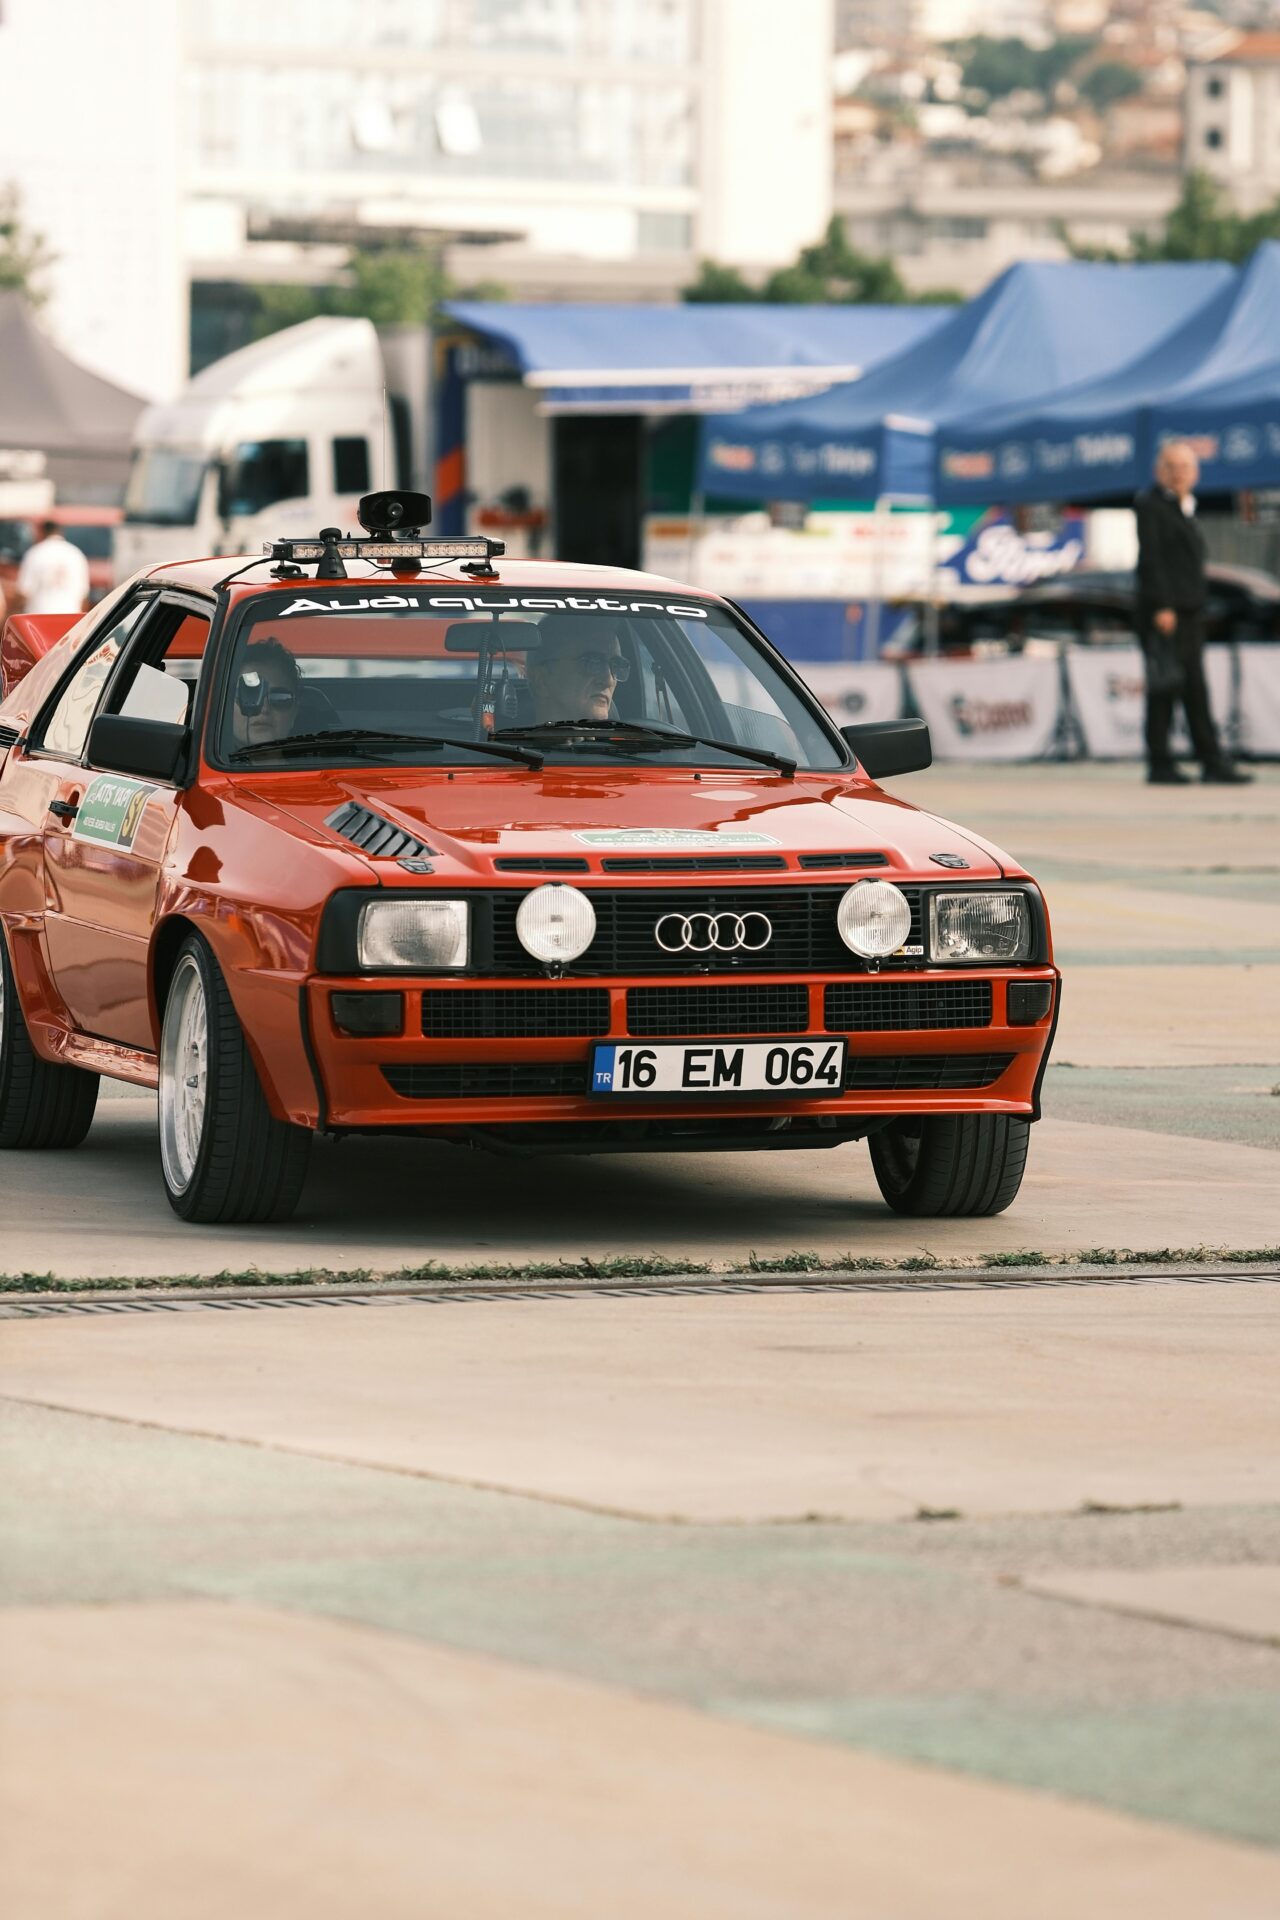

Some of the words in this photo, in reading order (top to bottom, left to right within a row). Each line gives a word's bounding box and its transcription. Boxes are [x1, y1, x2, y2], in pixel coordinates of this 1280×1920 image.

[277, 595, 419, 617] Audi
[427, 596, 708, 619] quattro
[906, 946, 922, 955] Agip
[596, 1072, 611, 1083] TR
[618, 1049, 657, 1088] 16
[681, 1048, 744, 1088] EM
[764, 1045, 839, 1086] 064
